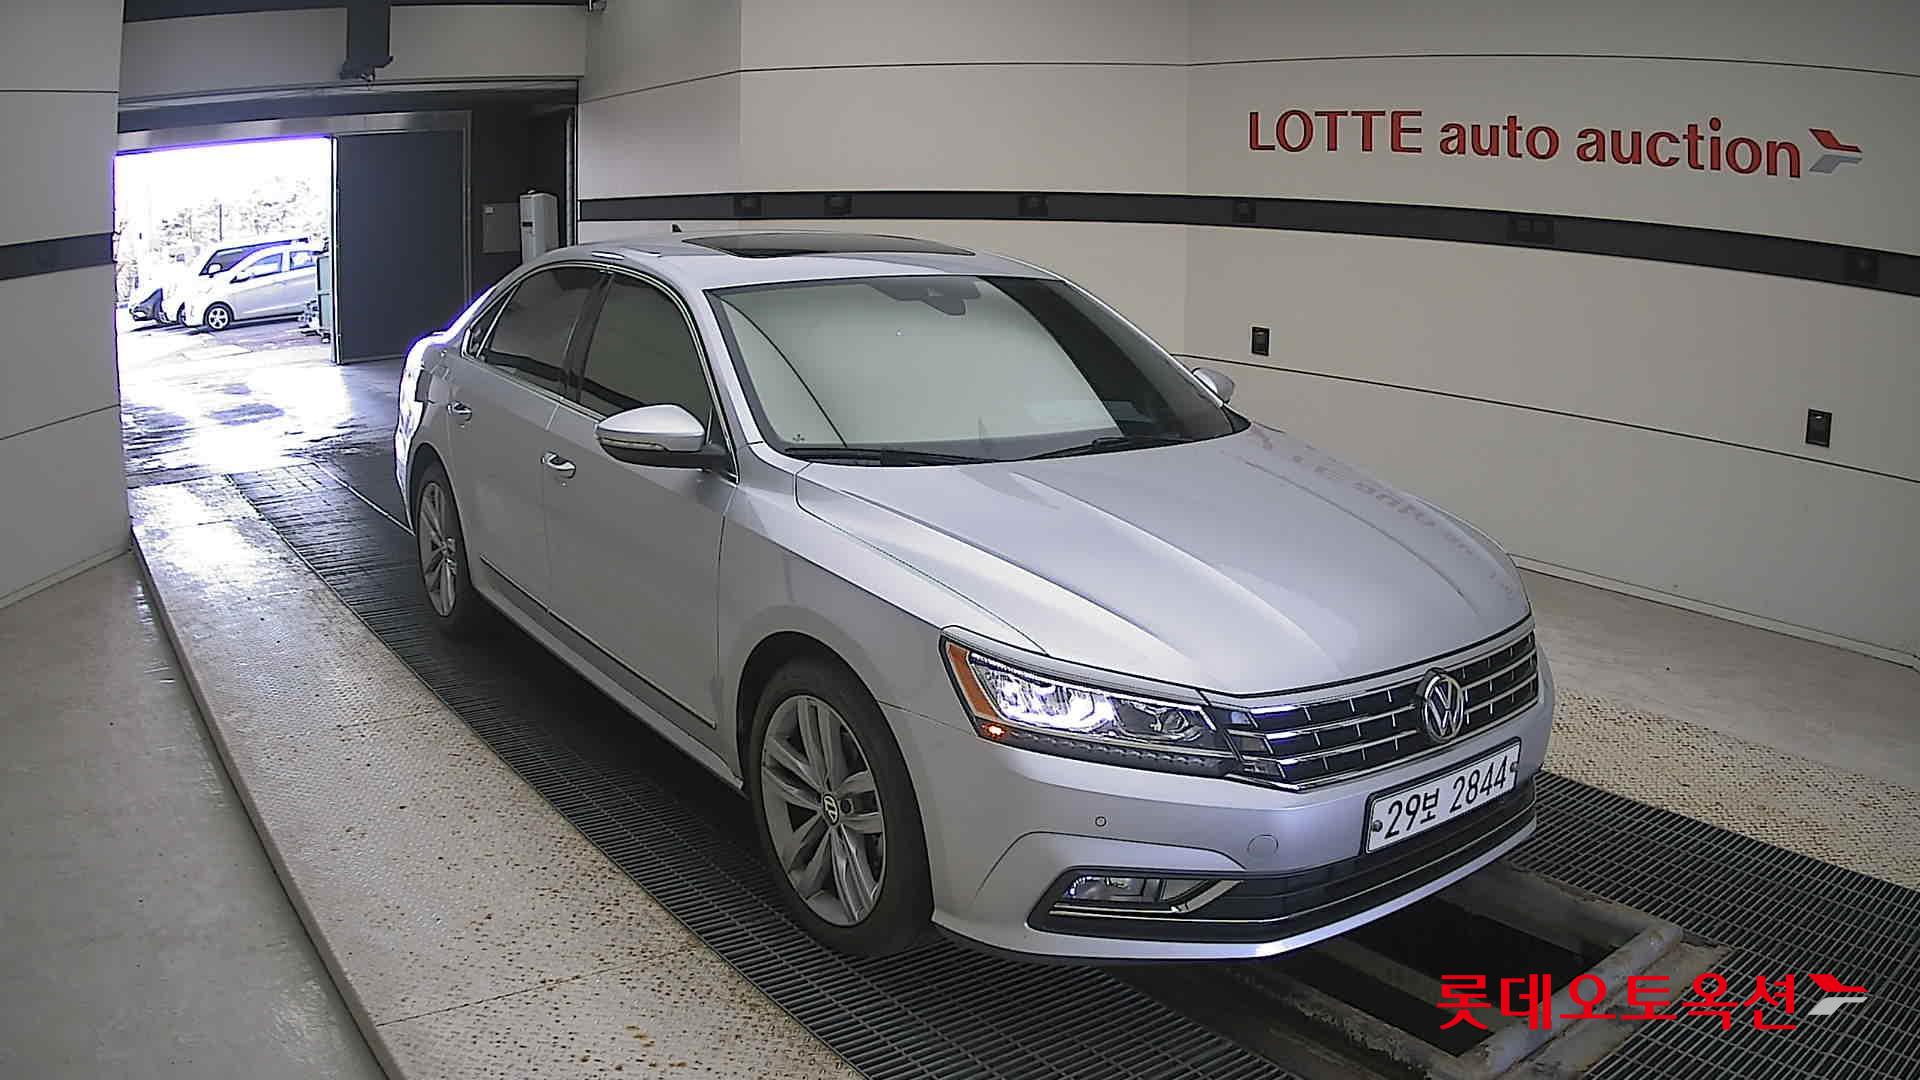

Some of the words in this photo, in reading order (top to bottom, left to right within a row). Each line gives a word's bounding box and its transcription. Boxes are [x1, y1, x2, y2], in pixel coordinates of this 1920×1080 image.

[1249, 109, 1424, 155] LOTTE
[1440, 115, 1561, 160] auto
[1577, 118, 1803, 178] auction
[1385, 788, 1440, 839] 29보
[1449, 756, 1508, 813] 2844
